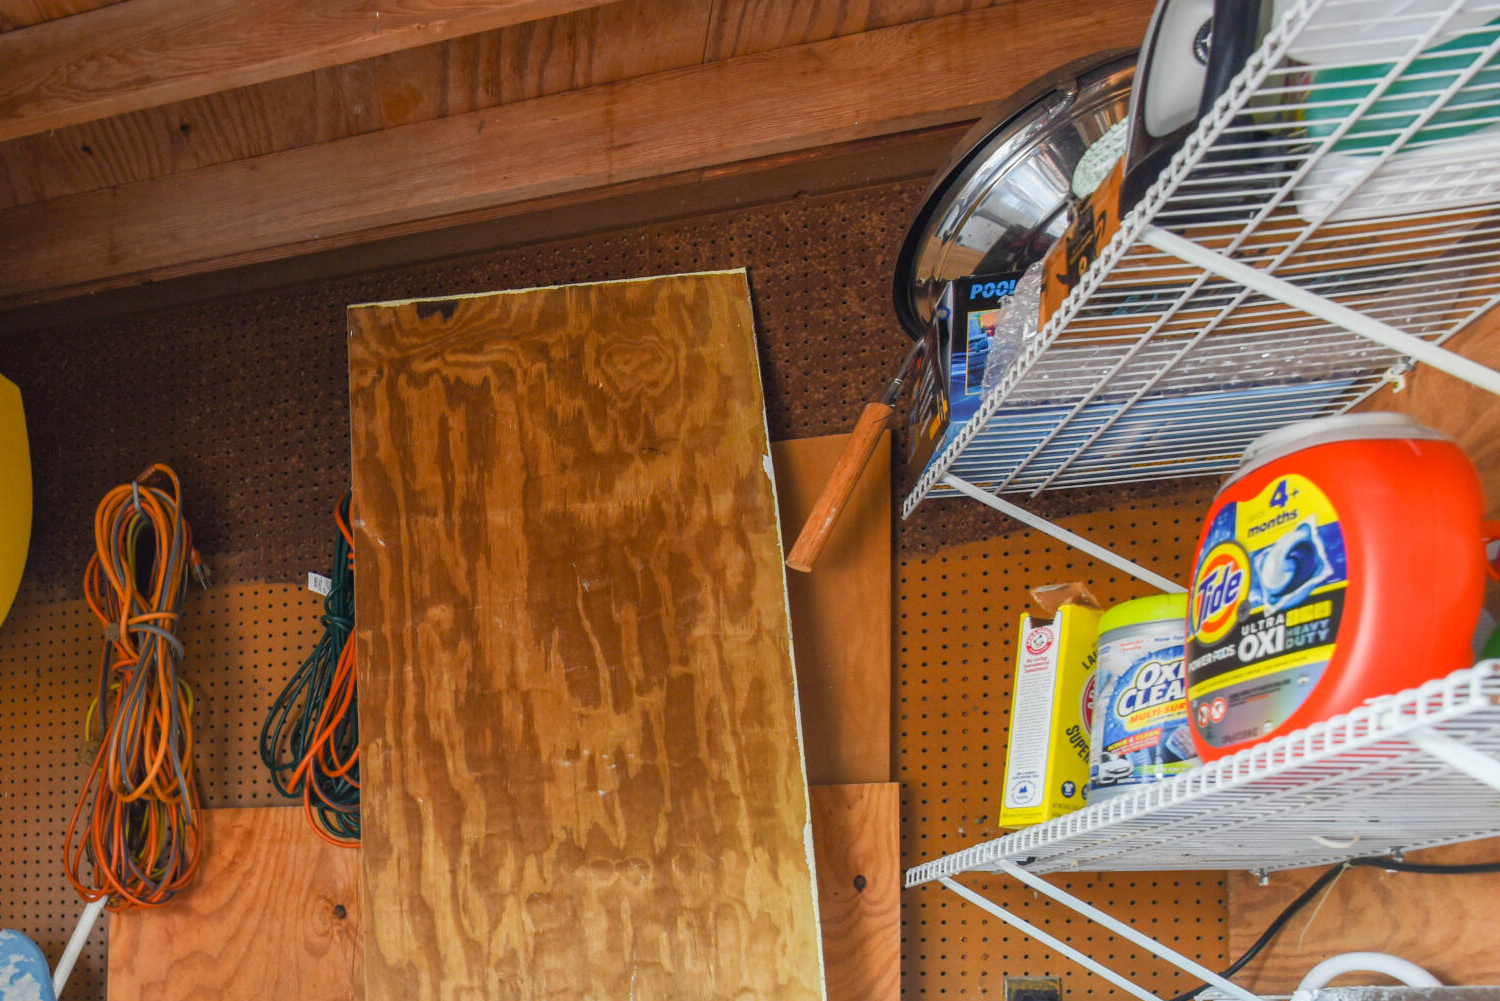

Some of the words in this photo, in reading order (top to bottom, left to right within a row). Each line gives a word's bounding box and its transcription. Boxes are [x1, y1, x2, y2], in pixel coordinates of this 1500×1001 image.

[1248, 508, 1298, 538] months
[1194, 561, 1244, 632] Tide
[1241, 613, 1285, 636] ULTRA
[1285, 618, 1331, 637] HEAVY
[1238, 625, 1285, 662] OXI
[1285, 629, 1331, 649] DUTY
[1117, 678, 1187, 717] CLEA
[1130, 701, 1187, 722] MULTI-SUR
